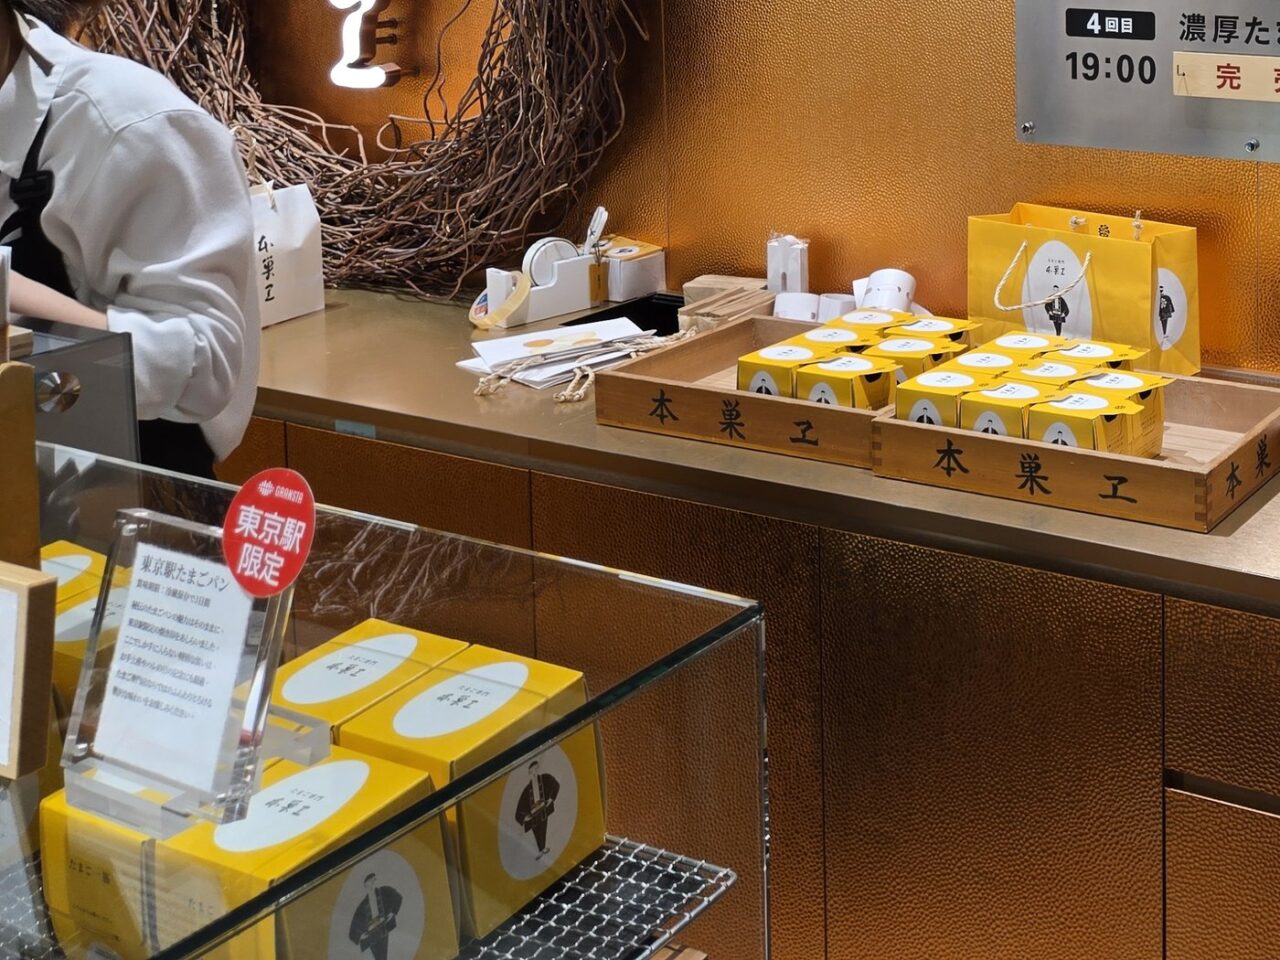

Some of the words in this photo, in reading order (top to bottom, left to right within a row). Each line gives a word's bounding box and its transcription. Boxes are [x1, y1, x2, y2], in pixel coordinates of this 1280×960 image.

[1086, 12, 1133, 34] 4回目
[1065, 51, 1157, 85] 19:00
[234, 505, 307, 554] 東京駅
[236, 542, 285, 587] 限定
